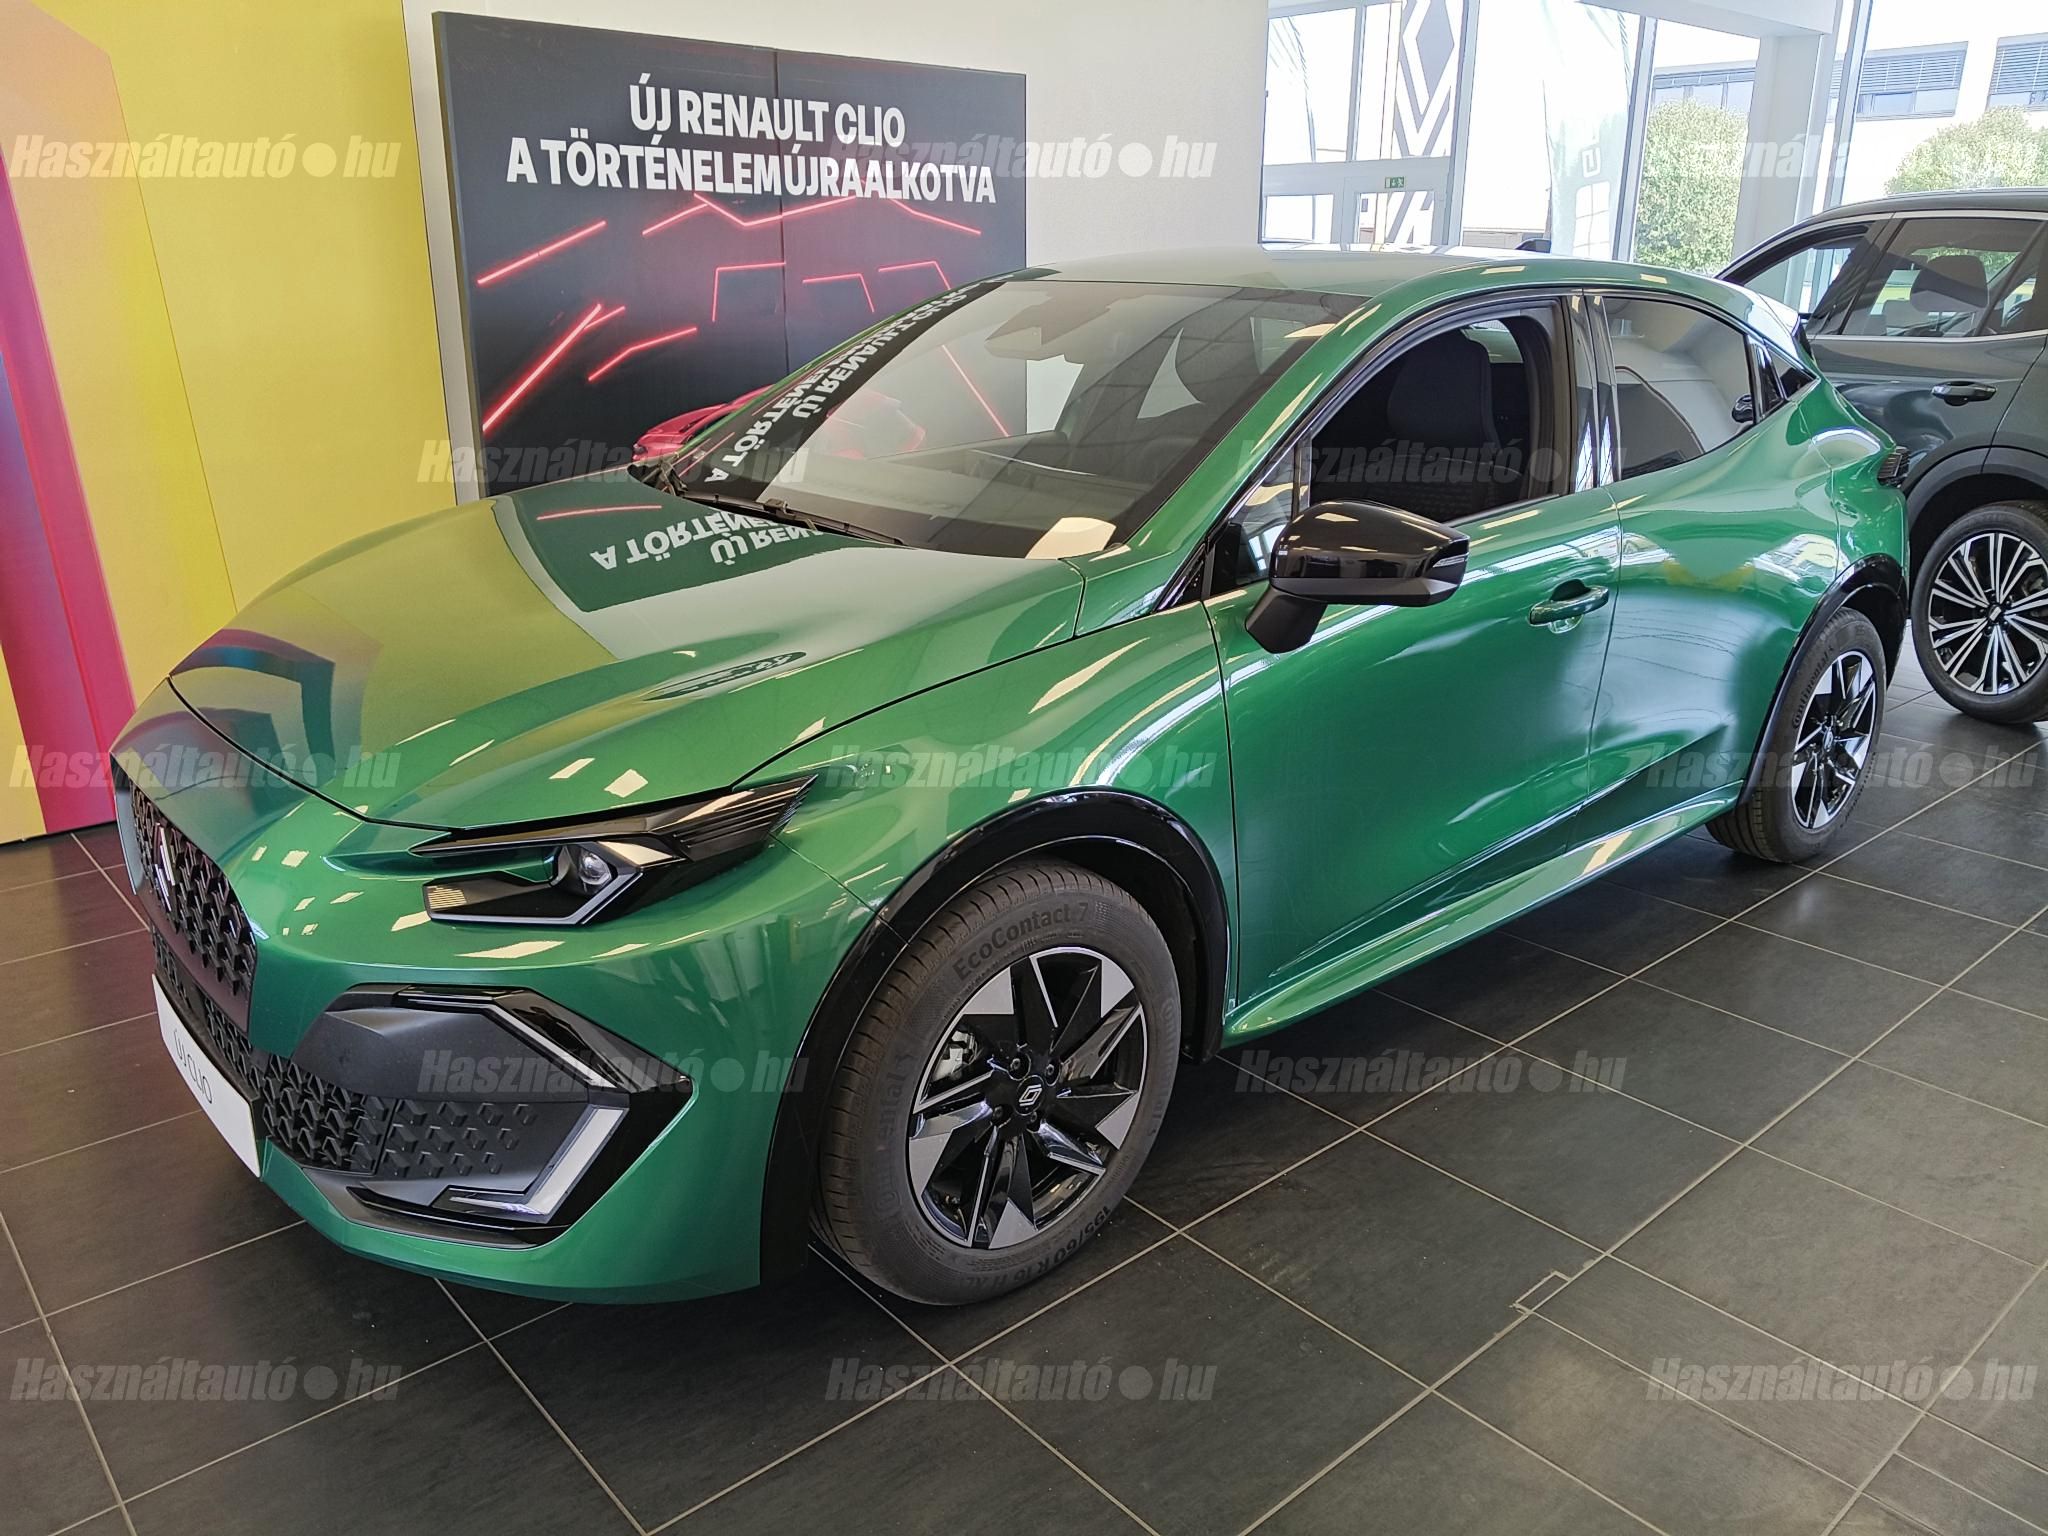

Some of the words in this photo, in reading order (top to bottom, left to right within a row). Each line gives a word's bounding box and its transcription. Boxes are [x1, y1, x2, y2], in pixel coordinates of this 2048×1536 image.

[629, 73, 671, 131] ÚJ
[678, 92, 830, 142] RENAULT
[835, 102, 906, 148] CLIO
[506, 137, 537, 184] A
[952, 903, 1072, 981] EcoContact
[1078, 902, 1089, 922] 7
